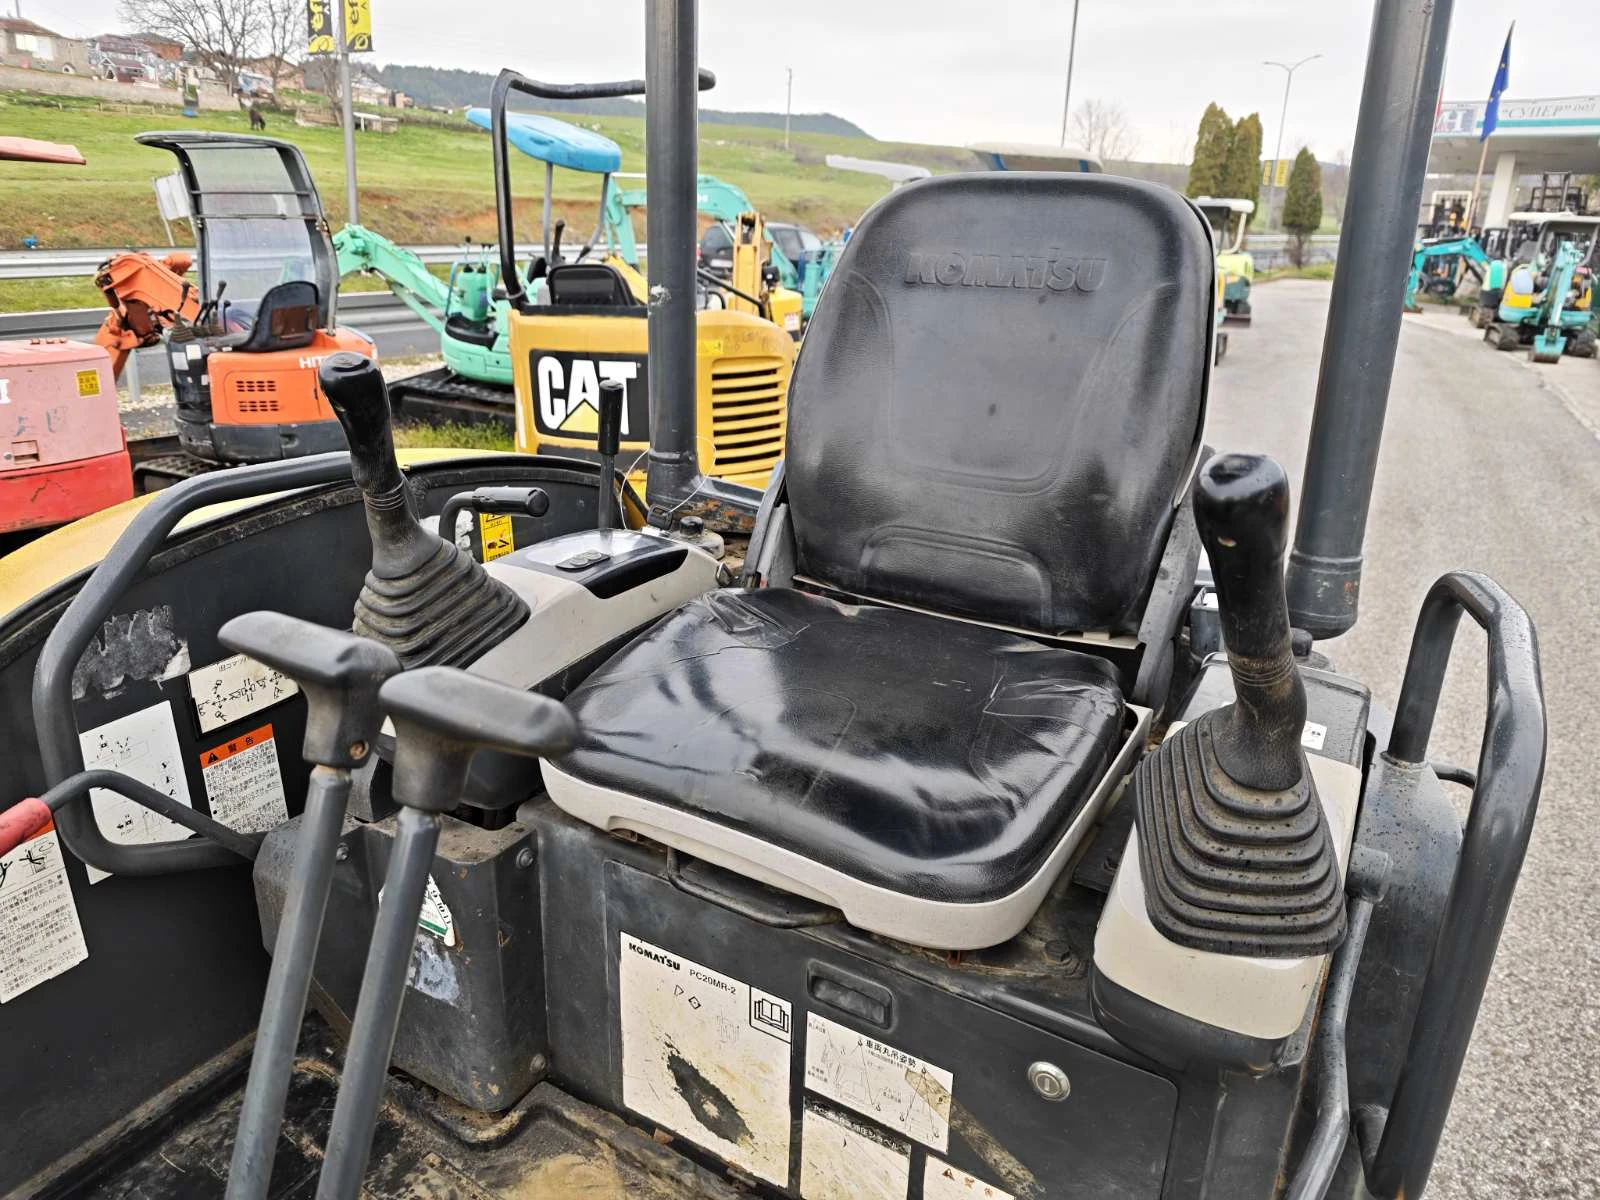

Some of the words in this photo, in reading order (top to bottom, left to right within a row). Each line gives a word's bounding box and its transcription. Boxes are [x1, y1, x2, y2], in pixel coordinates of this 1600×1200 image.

[903, 248, 1109, 293] KOMATSU
[537, 355, 638, 436] CAT
[628, 942, 681, 971] KOMATSU
[689, 968, 737, 996] PC20MR-2
